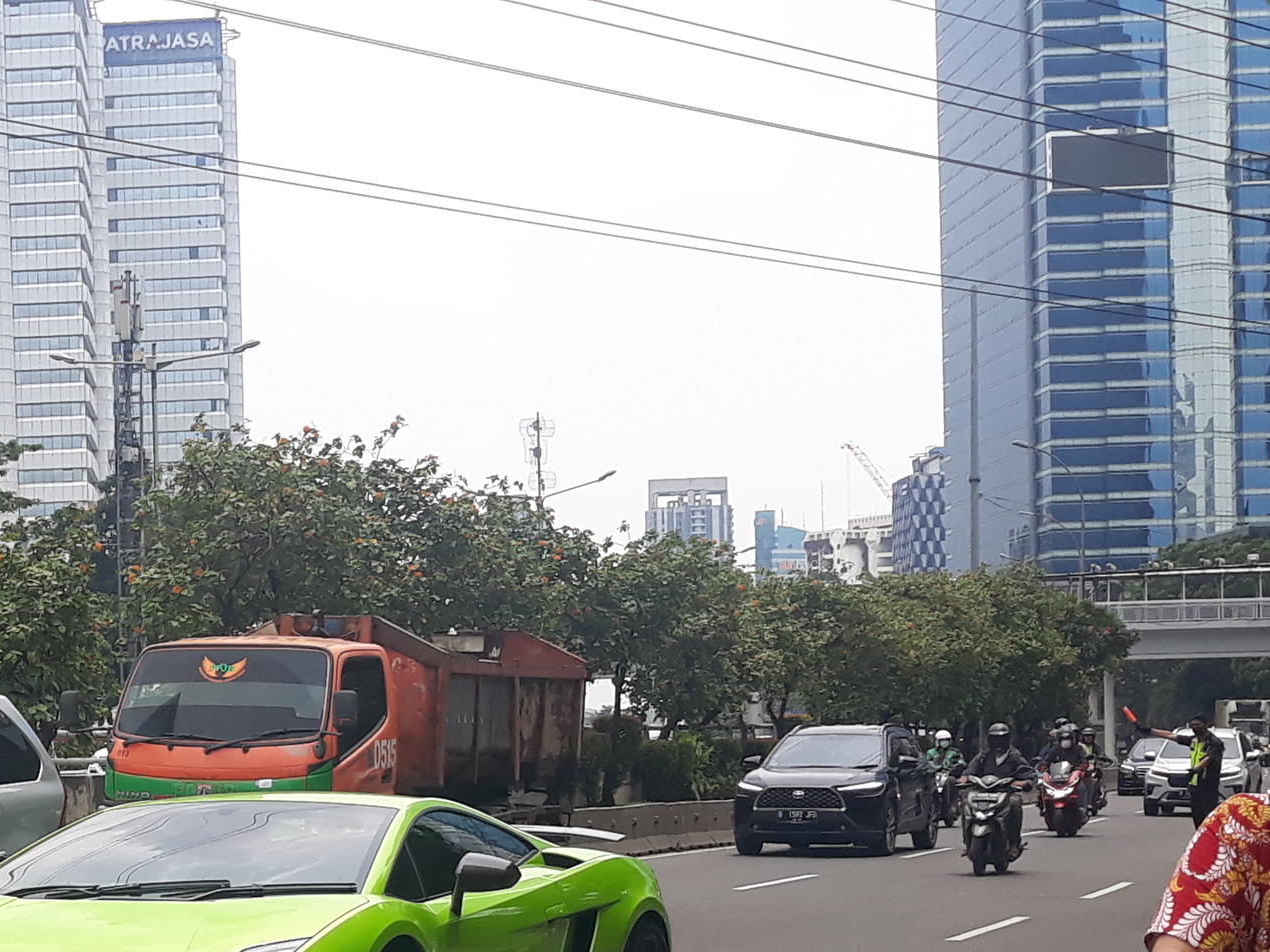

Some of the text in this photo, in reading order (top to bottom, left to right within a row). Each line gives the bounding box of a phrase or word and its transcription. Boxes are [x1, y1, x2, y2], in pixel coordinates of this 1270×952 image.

[102, 31, 214, 53] ATRAJASA
[374, 739, 397, 769] 0515
[116, 789, 151, 799] HINO
